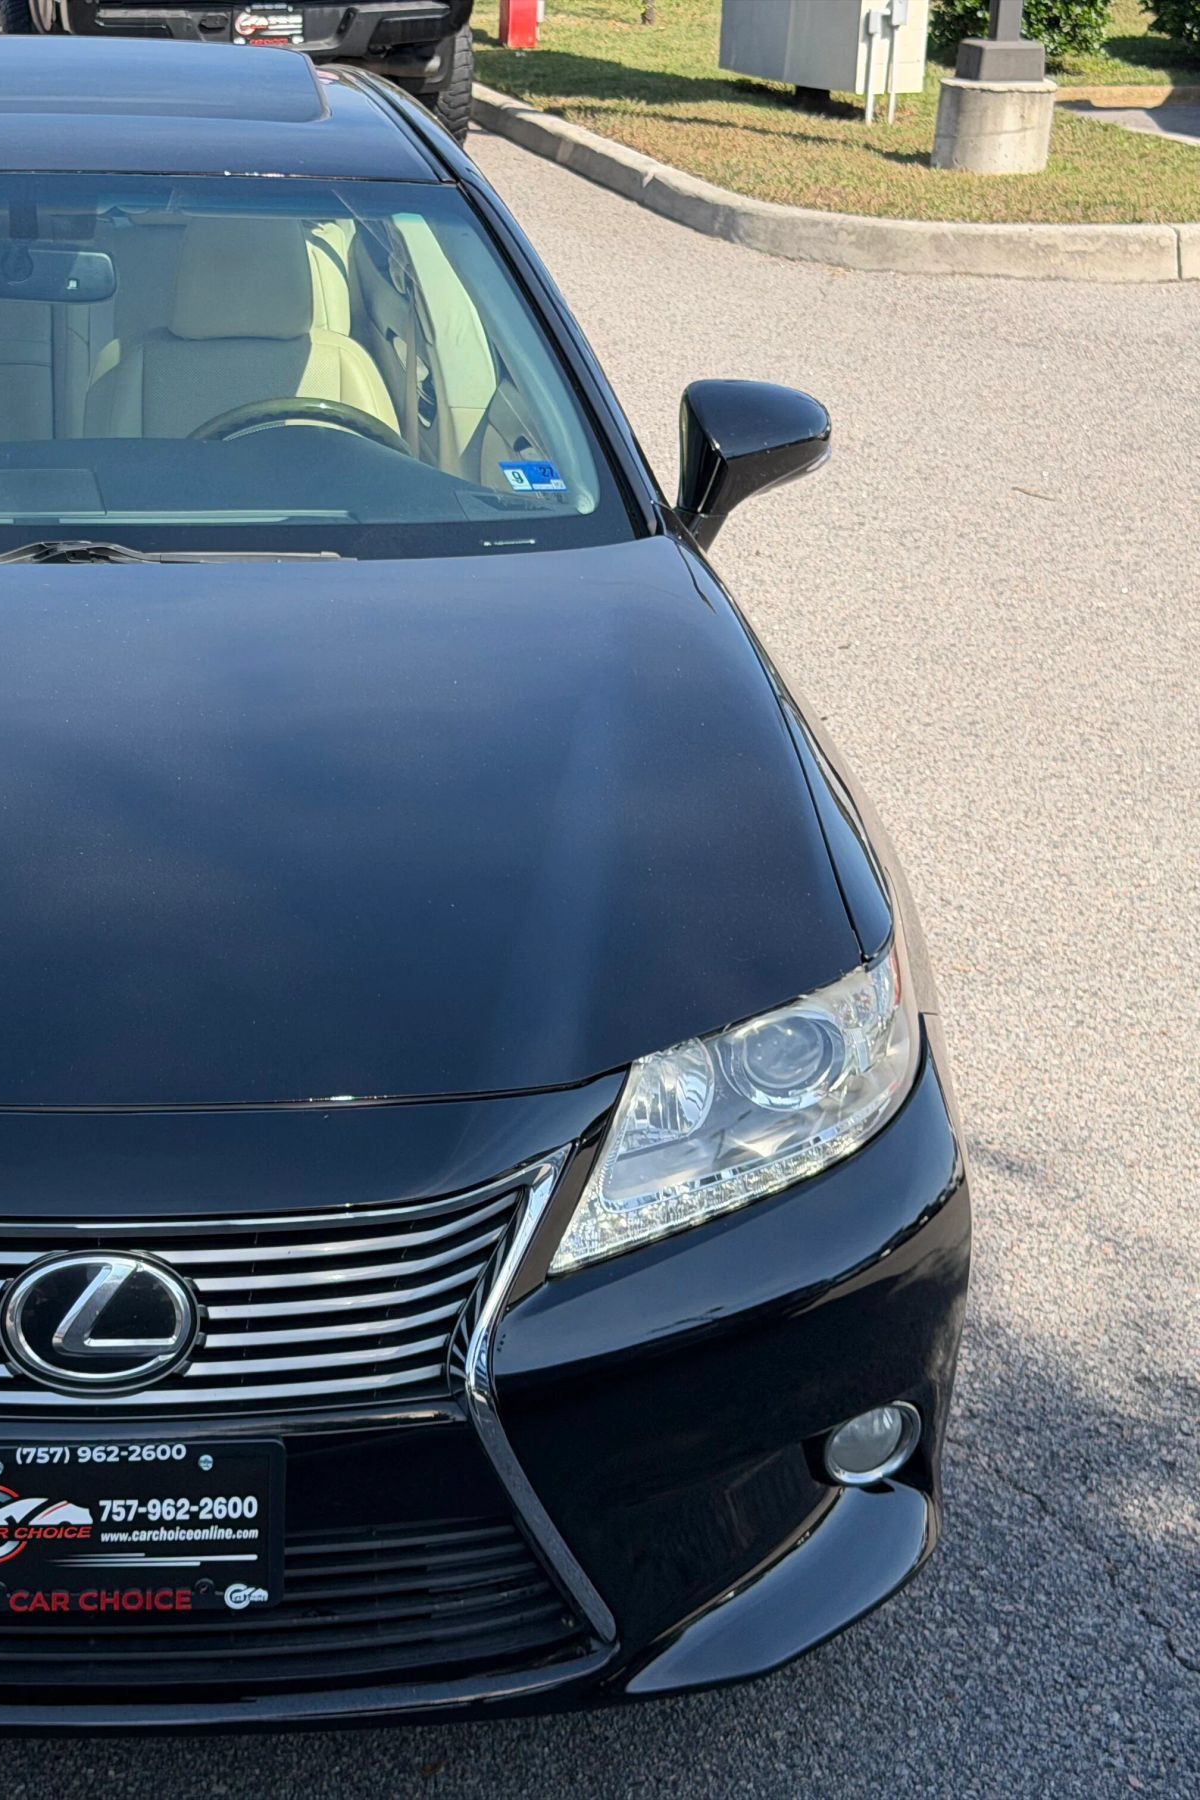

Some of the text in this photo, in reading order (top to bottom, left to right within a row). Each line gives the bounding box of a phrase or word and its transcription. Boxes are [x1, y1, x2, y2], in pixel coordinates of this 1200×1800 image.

[511, 470, 524, 484] 9
[15, 1444, 187, 1465] (757) 962-2600
[99, 1496, 258, 1522] 757-962-2600
[14, 1526, 92, 1539] CHOICE
[101, 1525, 259, 1542] www.carchoiceonline.com
[9, 1590, 192, 1612] CAR CHOICE
